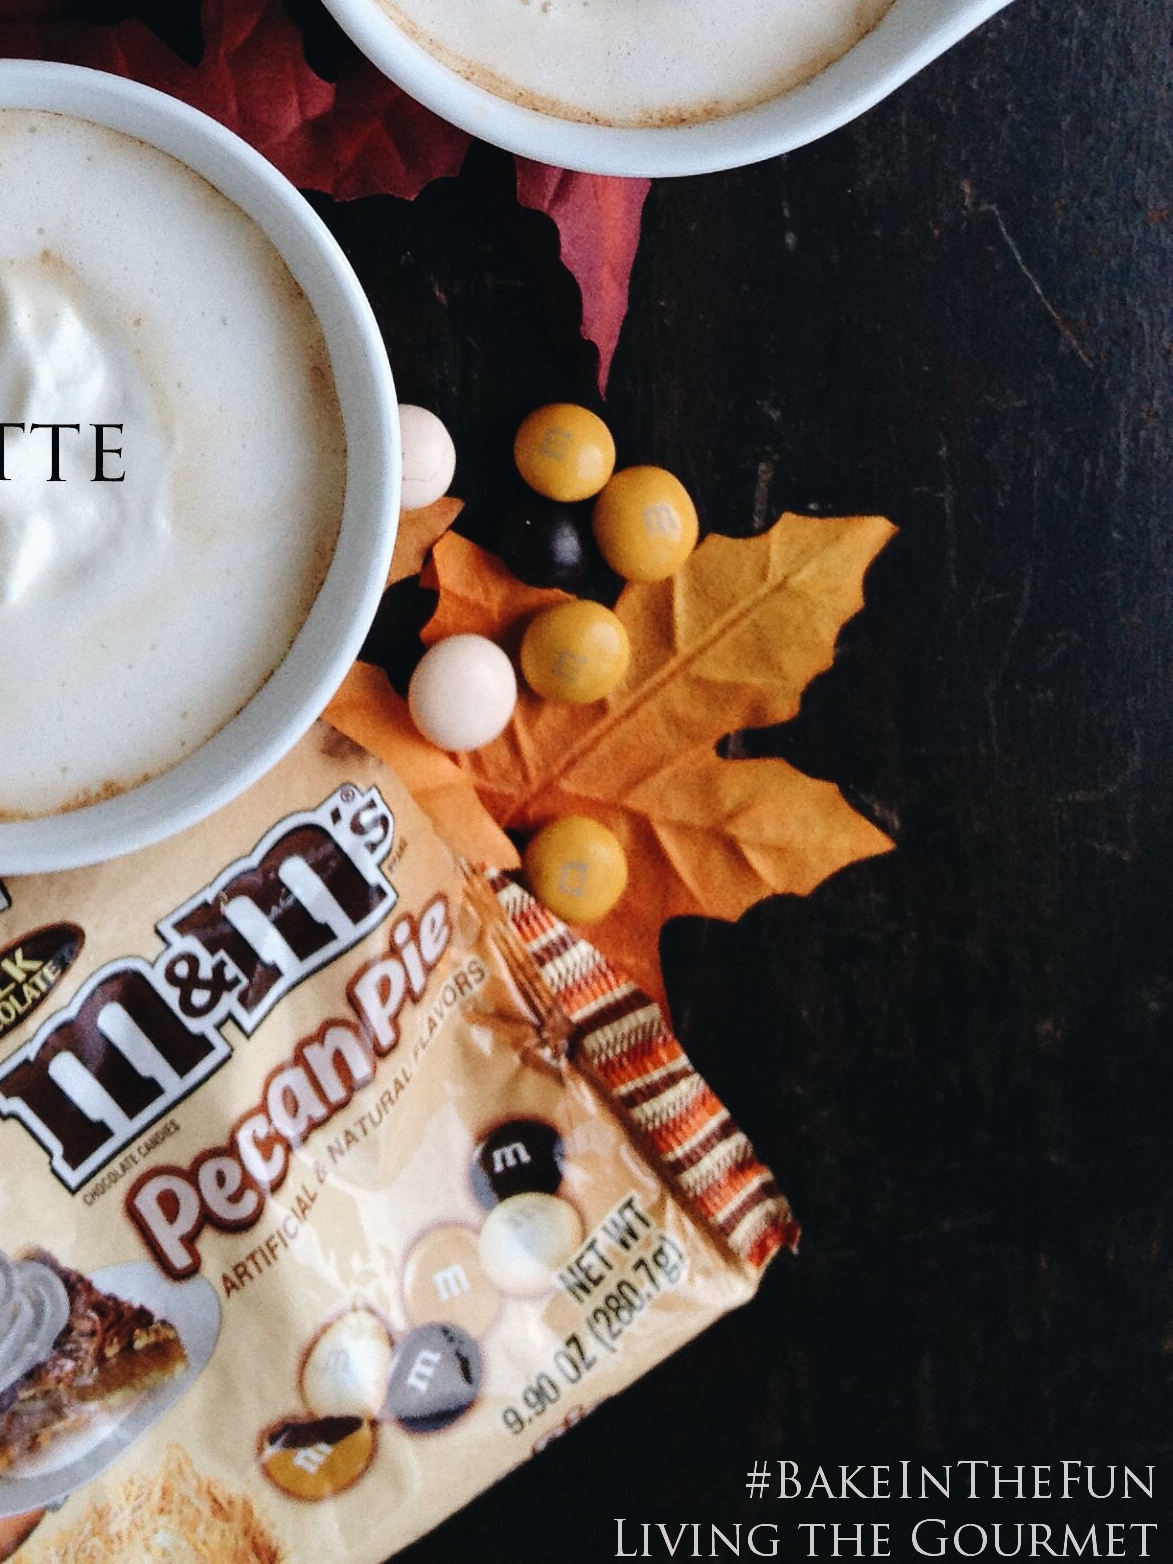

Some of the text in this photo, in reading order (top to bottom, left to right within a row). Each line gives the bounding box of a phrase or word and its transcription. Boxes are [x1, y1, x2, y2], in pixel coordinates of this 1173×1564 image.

[125, 891, 453, 1282] Pecan Pie
[220, 1184, 318, 1300] ARTIFICIAL
[326, 1066, 413, 1166] NATURAL
[412, 958, 487, 1062] FLAVORS
[83, 1118, 180, 1206] CHOCOLATE CANDIES
[492, 1141, 532, 1174] m
[432, 1263, 471, 1302] m
[557, 1193, 652, 1304] NET WT
[501, 1371, 561, 1435] 9.90
[553, 1332, 597, 1385] OZ
[586, 1234, 686, 1354] (280.7g)
